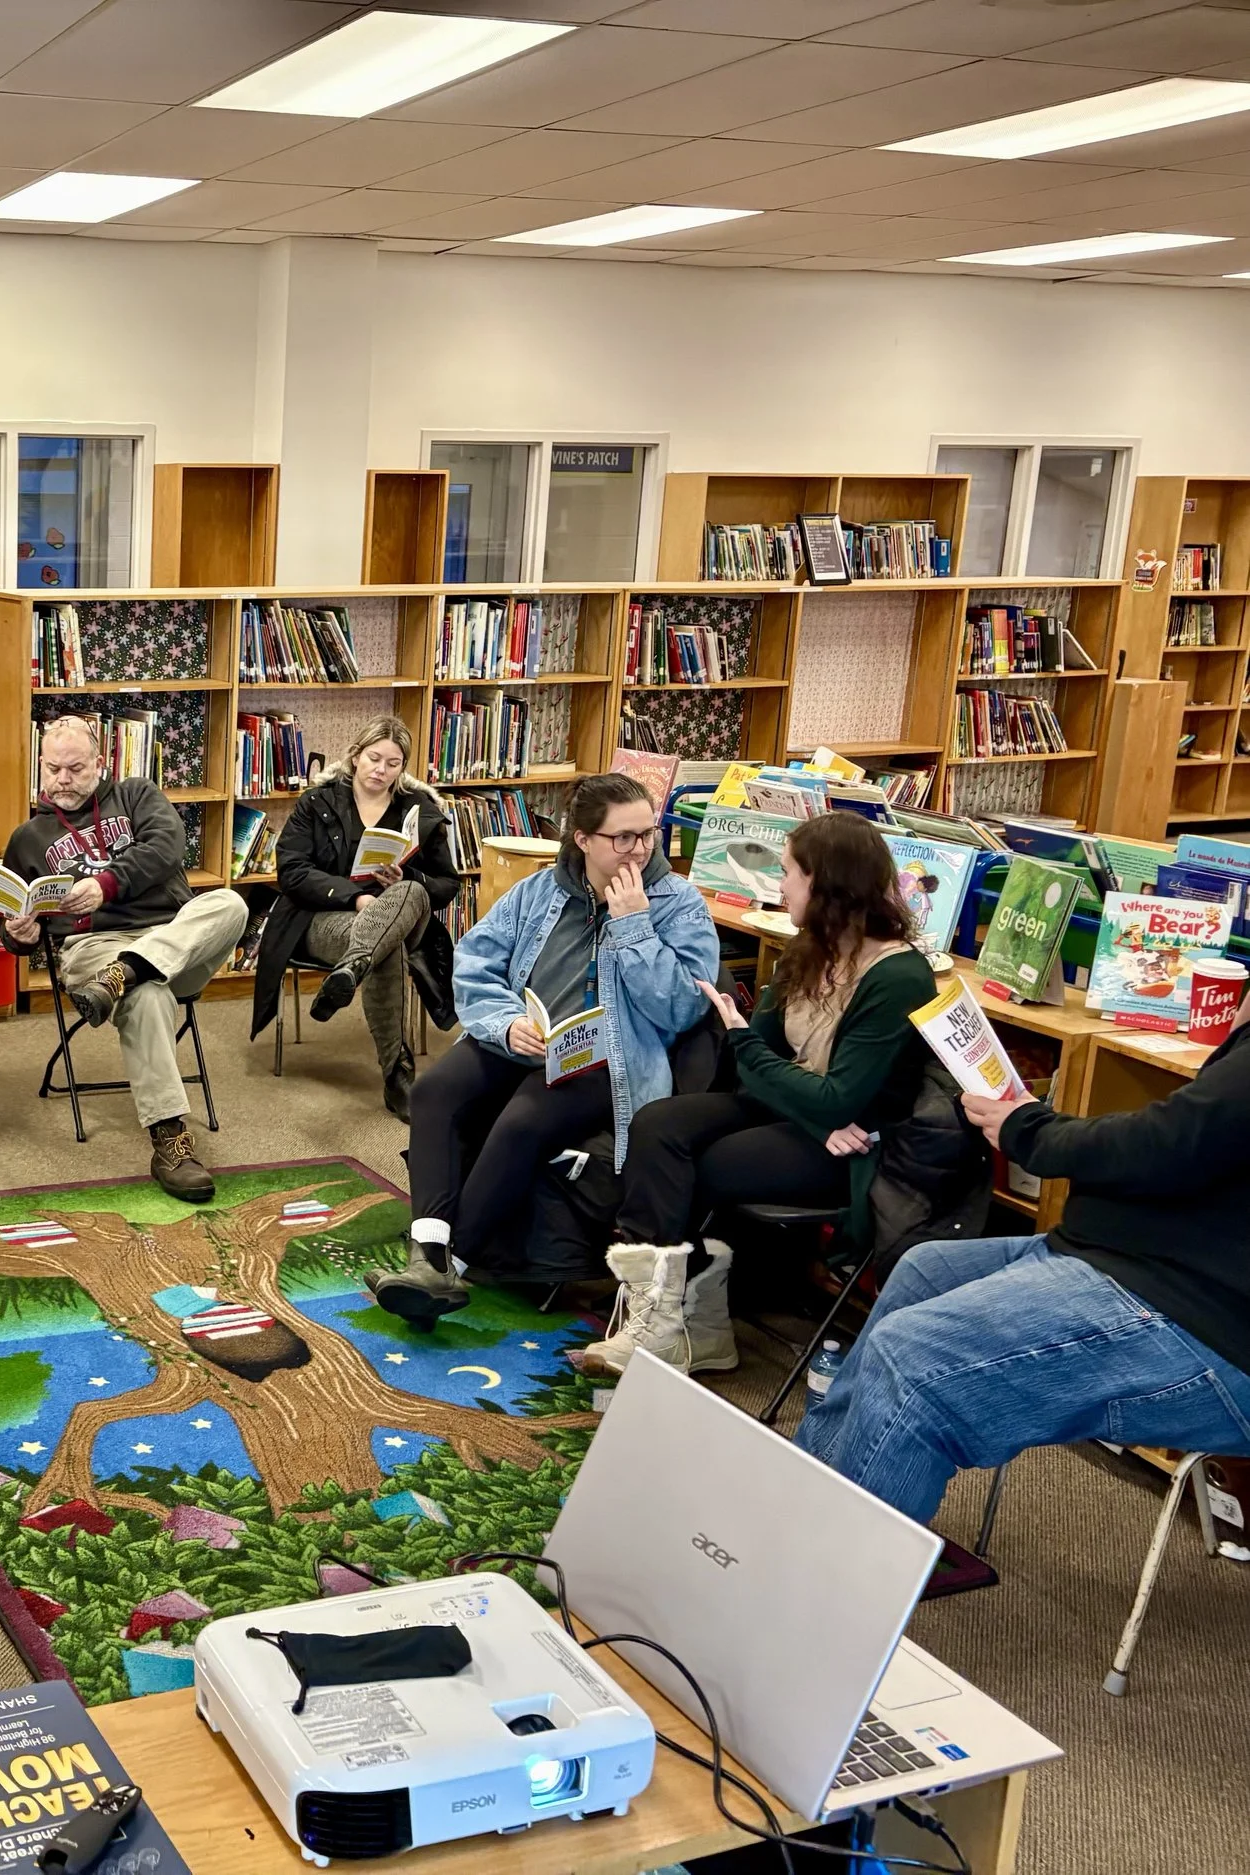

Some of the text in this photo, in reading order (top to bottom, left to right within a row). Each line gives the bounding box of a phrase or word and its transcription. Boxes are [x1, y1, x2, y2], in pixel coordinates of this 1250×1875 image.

[552, 451, 619, 466] VINE'S PATCH
[707, 816, 745, 836] ORCA
[892, 842, 936, 862] REFLECTION
[31, 888, 66, 900] TEACHER
[39, 883, 58, 892] NEW
[1121, 901, 1203, 920] Where are you
[997, 906, 1047, 942] green
[1148, 913, 1221, 940] Bear?
[1197, 984, 1234, 1008] Tim
[946, 1001, 970, 1030] NEW
[553, 1027, 598, 1055] TEACHER
[563, 1023, 586, 1042] NEW
[692, 1532, 739, 1569] acer
[0, 1731, 29, 1743] Better
[29, 1726, 43, 1736] for
[40, 1733, 56, 1744] 98
[451, 1793, 497, 1814] EPSON
[0, 1843, 44, 1863] Great
